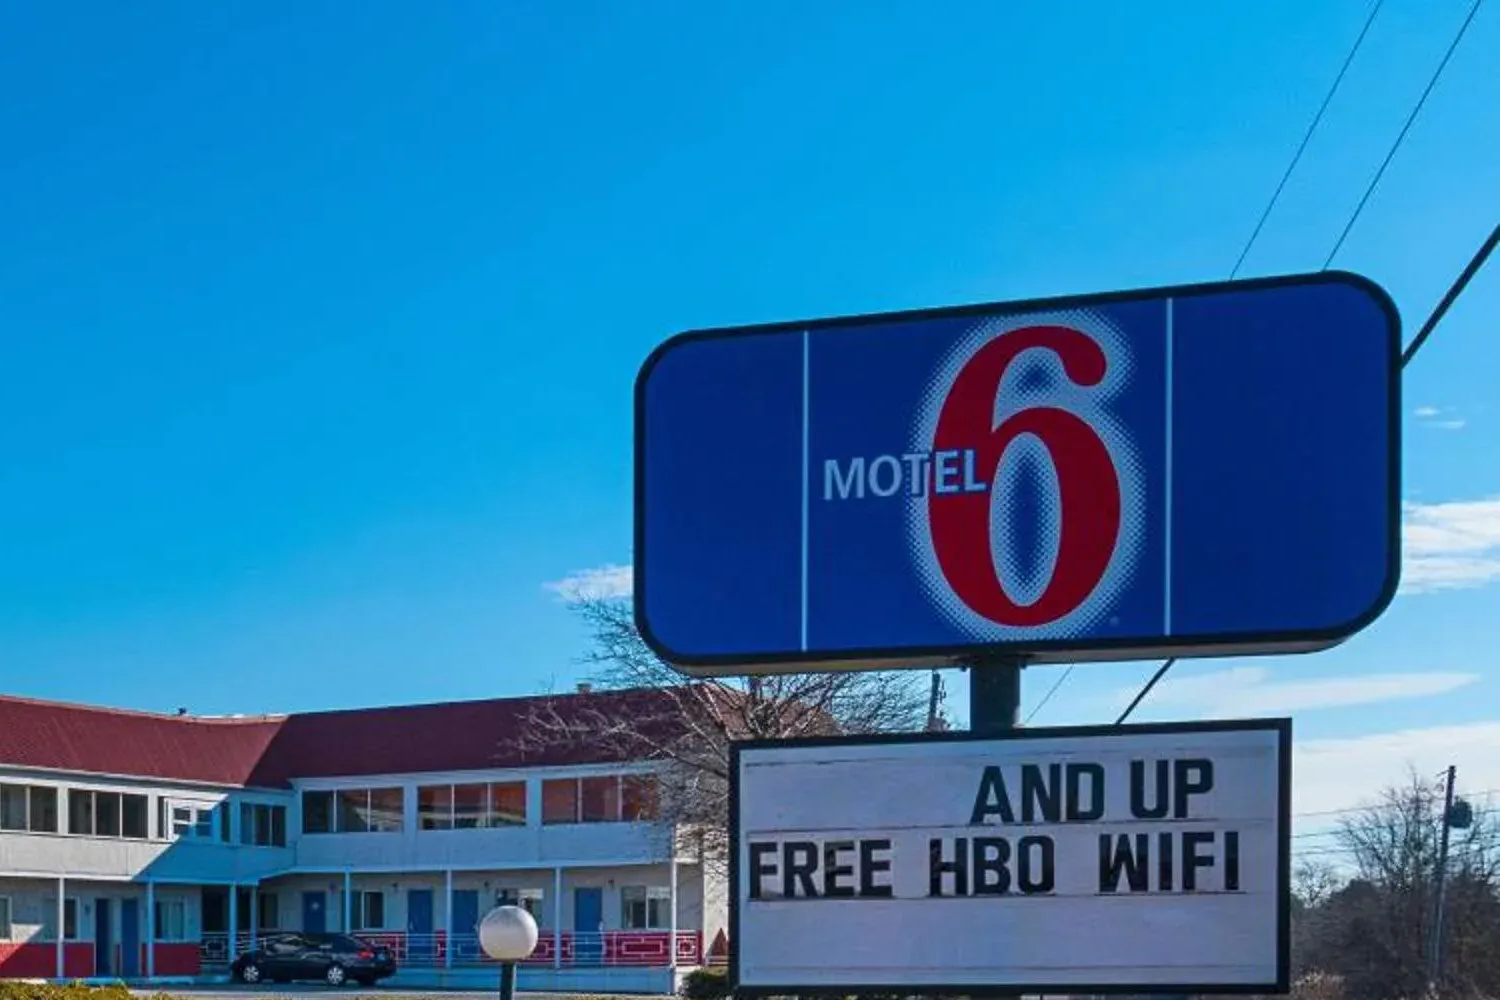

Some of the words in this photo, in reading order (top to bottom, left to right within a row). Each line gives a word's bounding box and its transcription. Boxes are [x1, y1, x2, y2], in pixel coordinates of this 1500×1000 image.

[824, 449, 987, 501] MOTEL
[927, 325, 1121, 627] 6
[969, 762, 1105, 826] AND
[1130, 758, 1213, 819] UP
[749, 839, 893, 899] FREE
[929, 835, 1055, 896] HBO
[1100, 831, 1239, 892] WIFI
